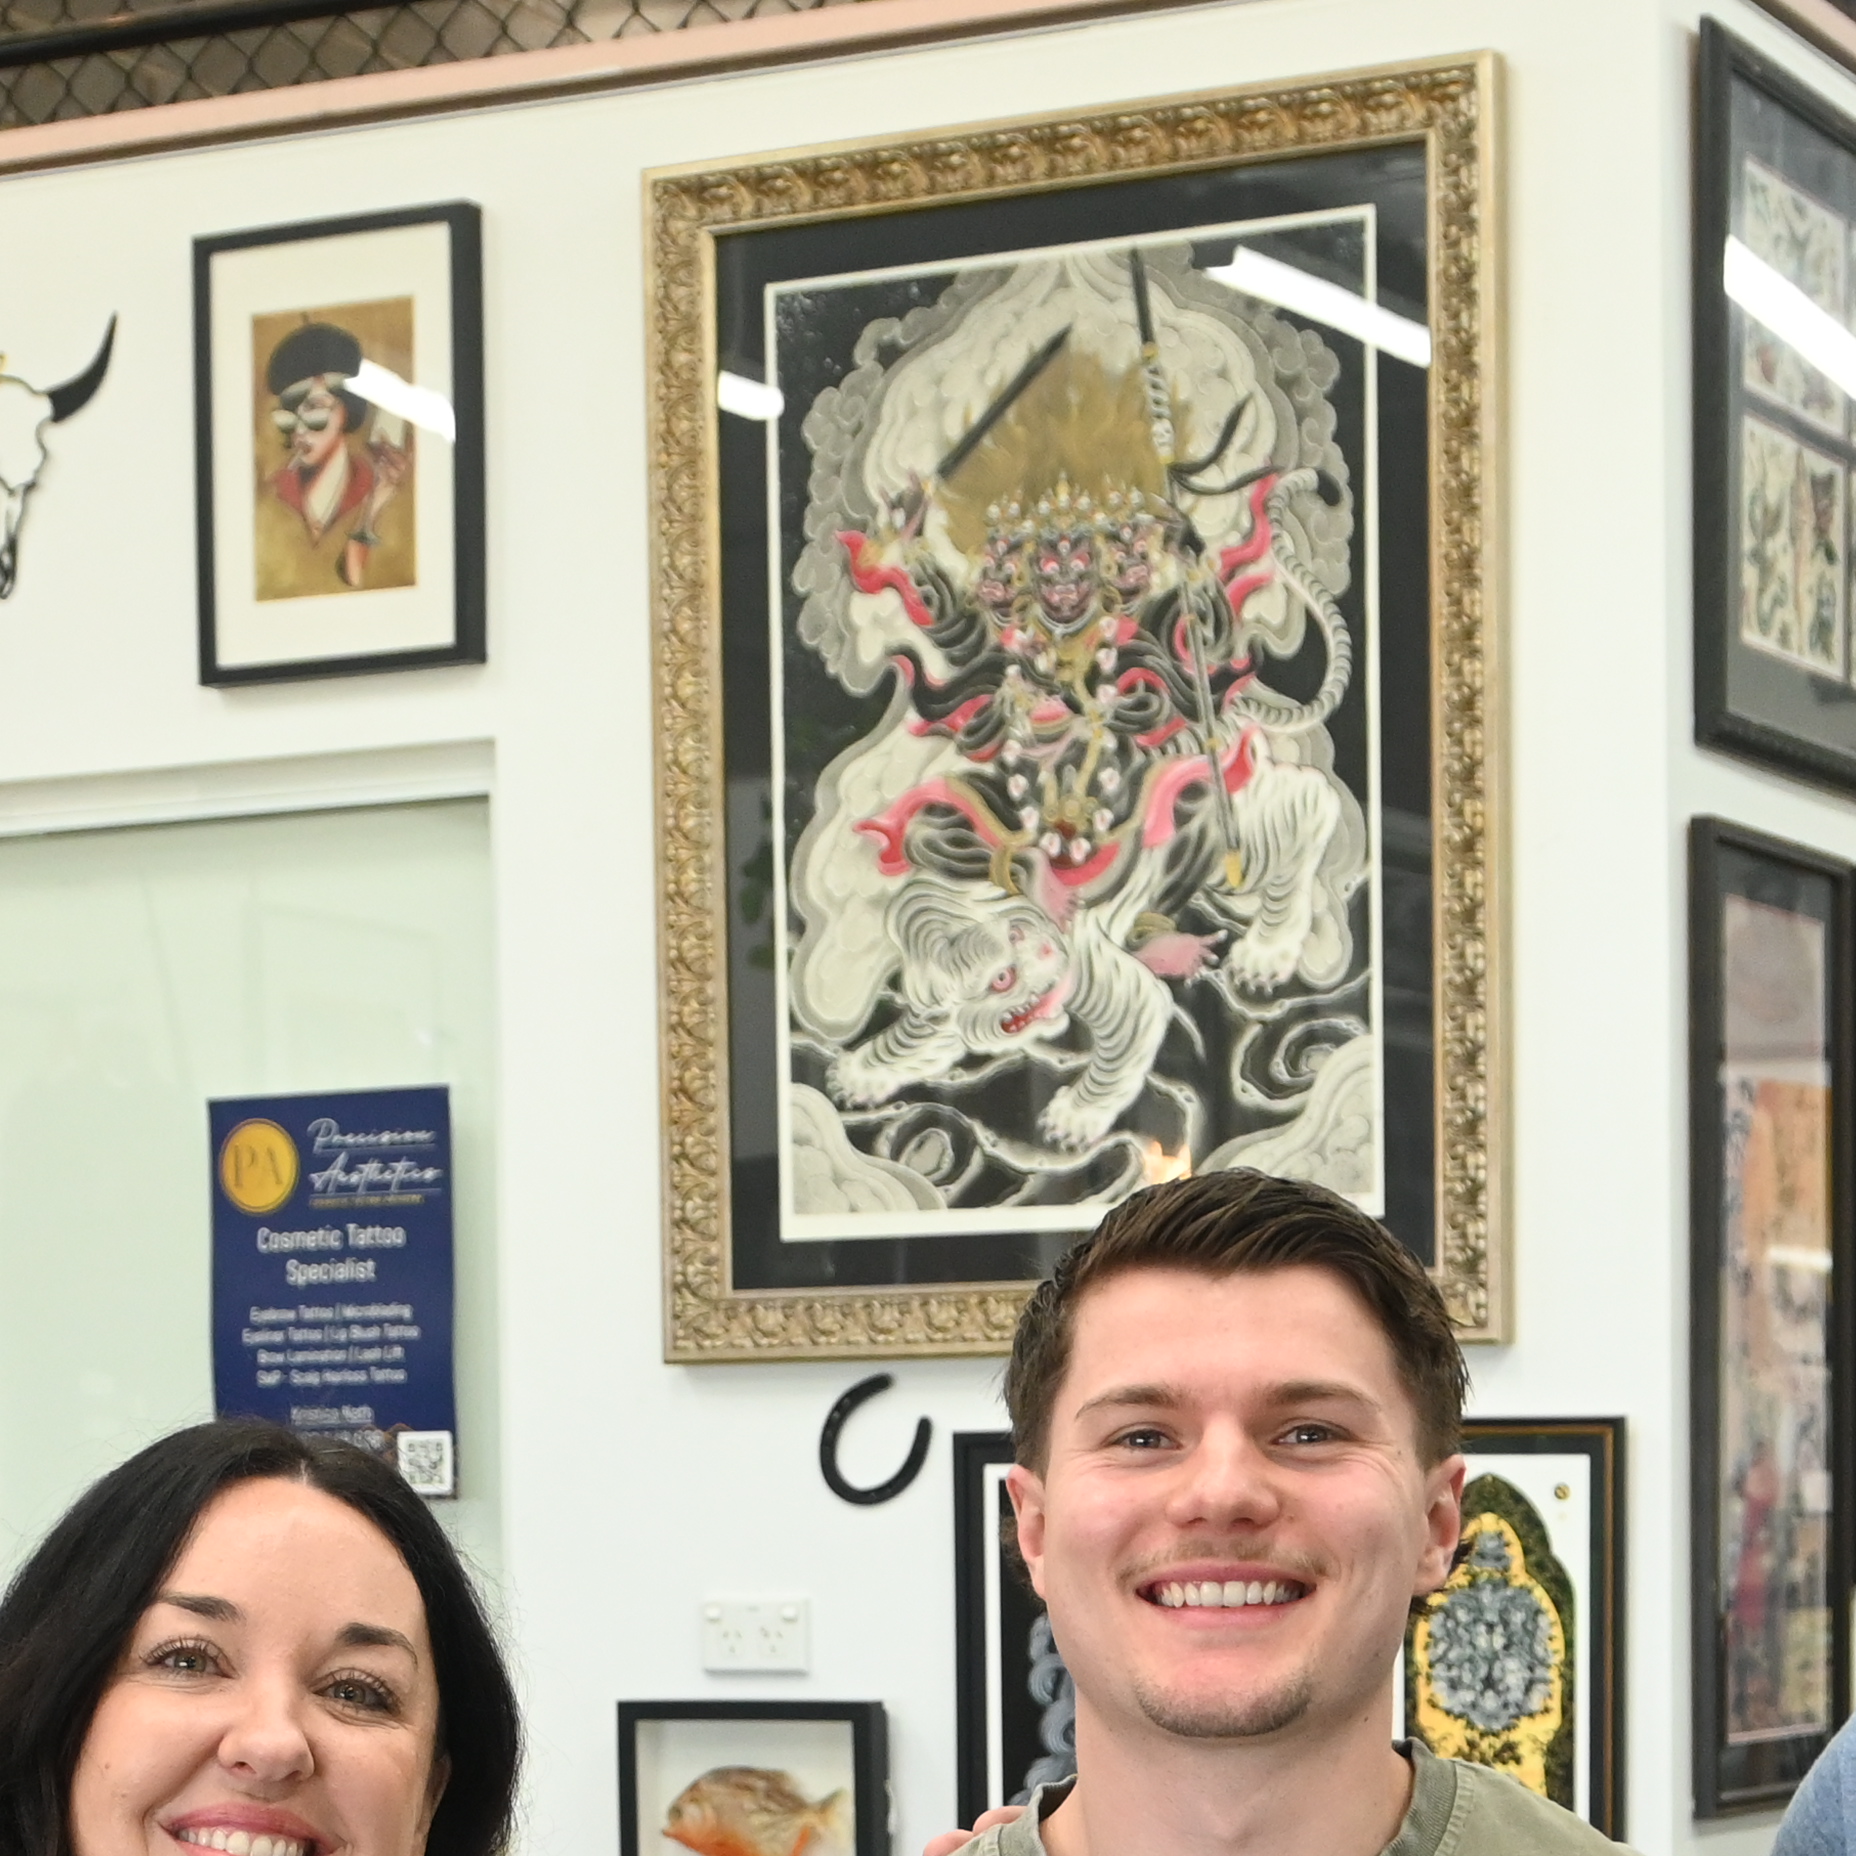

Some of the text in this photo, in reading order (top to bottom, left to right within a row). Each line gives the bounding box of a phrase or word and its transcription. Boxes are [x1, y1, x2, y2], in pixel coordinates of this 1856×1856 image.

[233, 1145, 283, 1188] PA
[257, 1223, 407, 1253] Cosmetic Tattoo
[286, 1257, 377, 1289] Specialist
[298, 1304, 334, 1322] Tattoo
[287, 1326, 323, 1344] Tattoo
[383, 1322, 421, 1341] Tattoo
